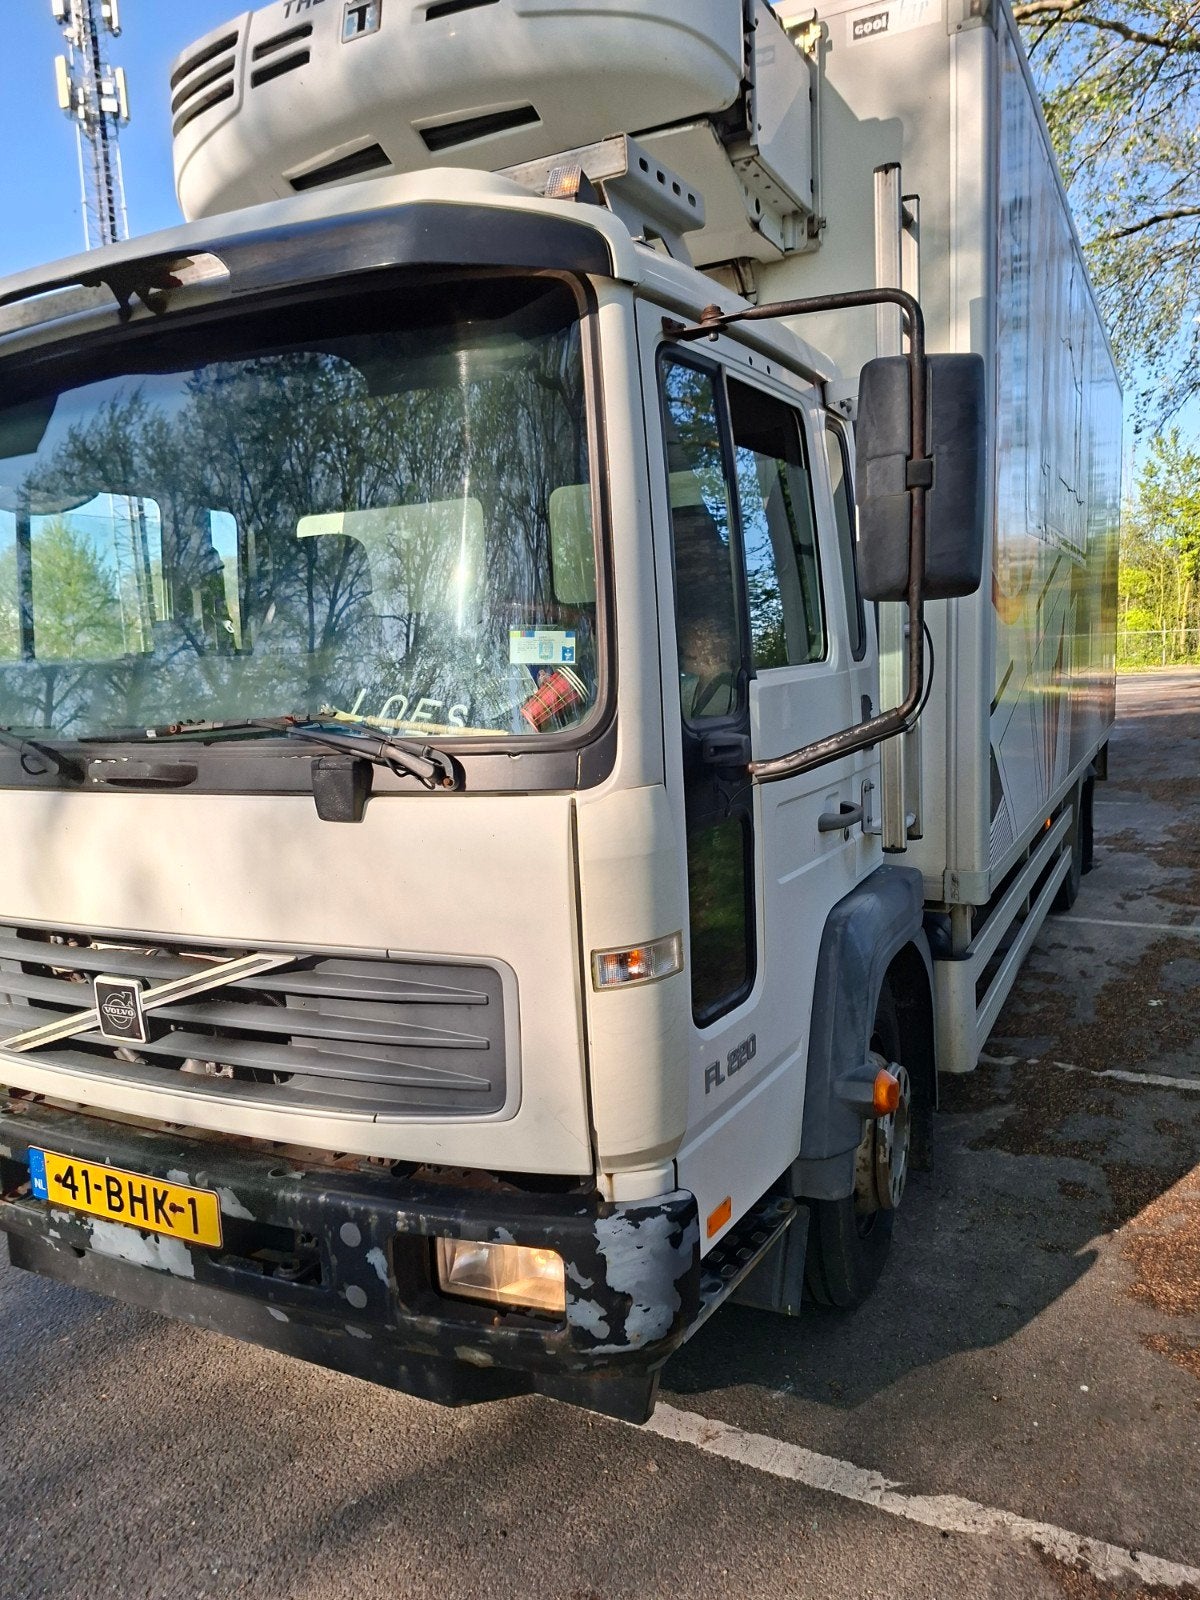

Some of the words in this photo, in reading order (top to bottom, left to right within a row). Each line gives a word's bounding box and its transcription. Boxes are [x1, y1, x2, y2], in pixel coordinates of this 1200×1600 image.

[103, 1006, 134, 1018] VOLVO
[704, 1060, 726, 1095] FL
[727, 1032, 757, 1077] 220
[34, 1177, 46, 1191] NL
[61, 1165, 199, 1235] 41-BHK-1
